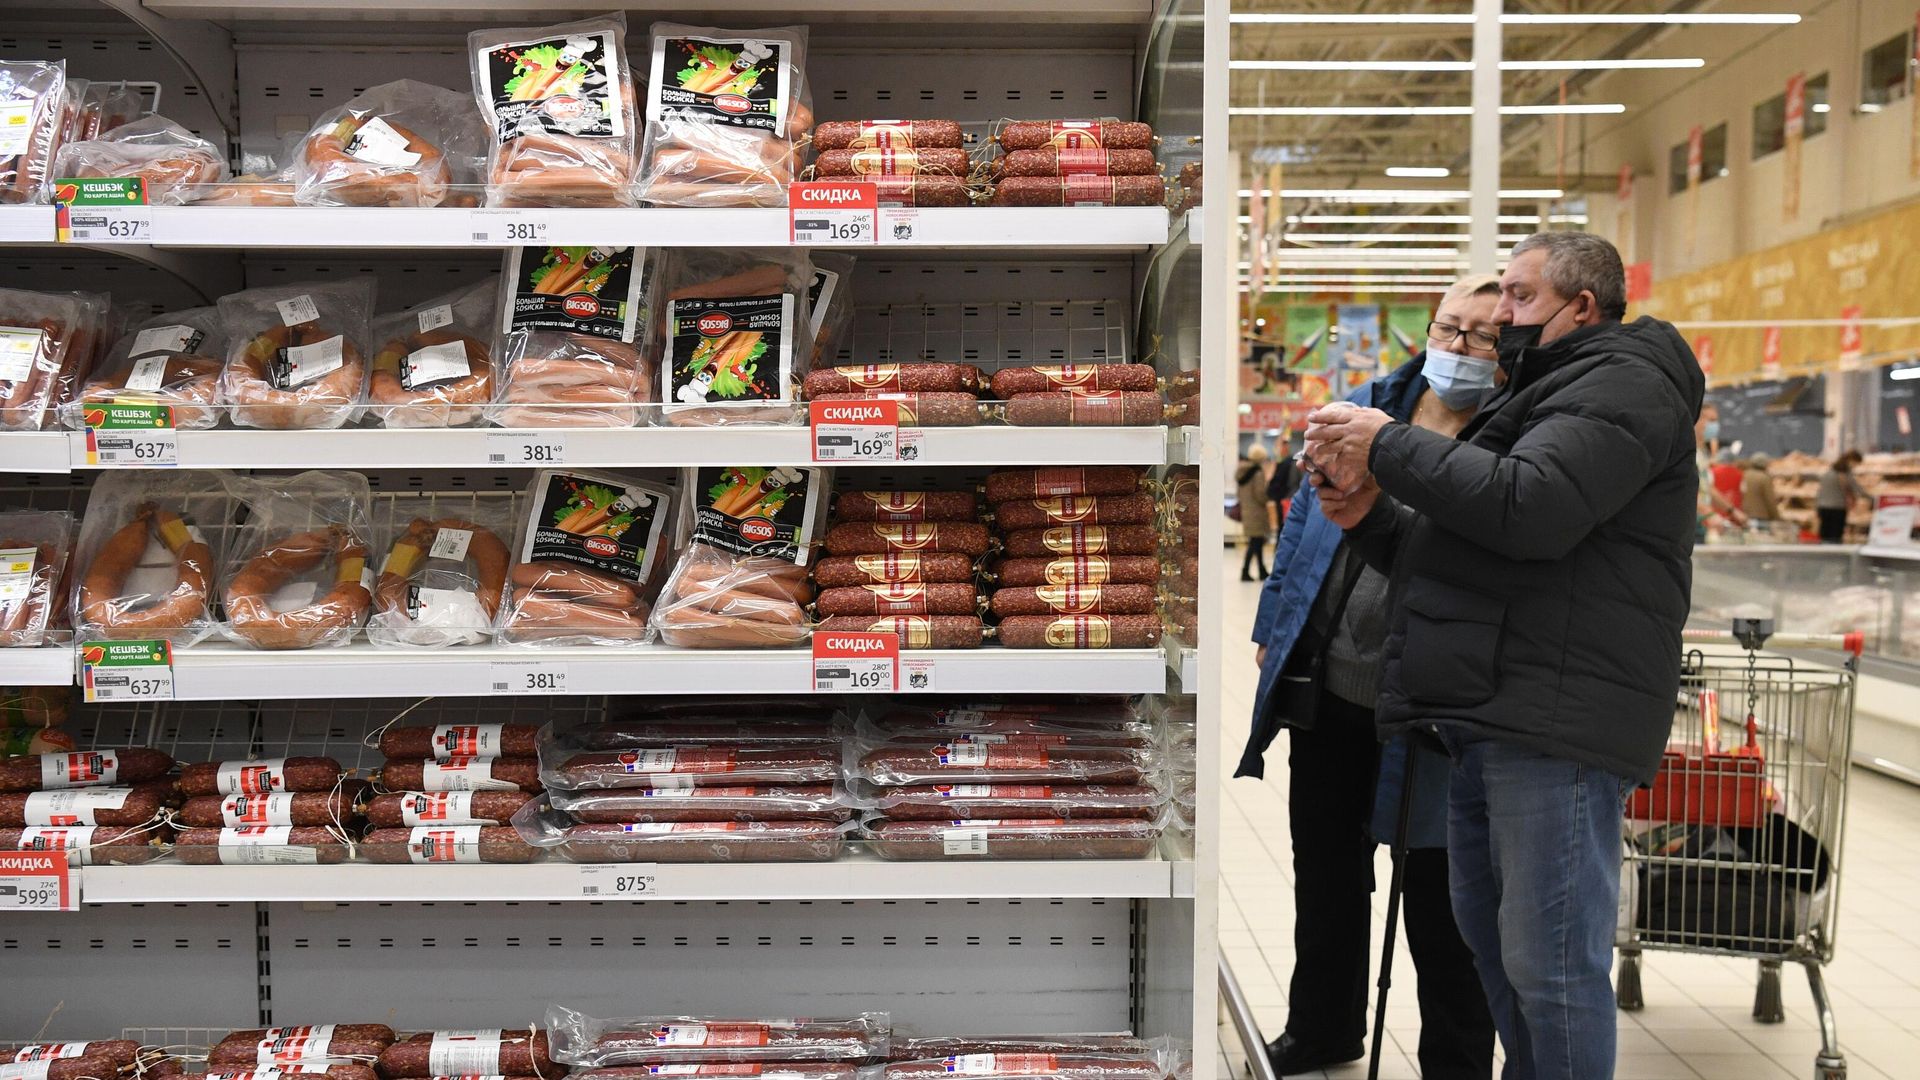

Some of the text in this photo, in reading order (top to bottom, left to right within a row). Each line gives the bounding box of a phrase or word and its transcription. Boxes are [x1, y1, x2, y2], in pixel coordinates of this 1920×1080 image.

[82, 183, 124, 192] КЕШБЭК
[802, 189, 862, 204] СКИДКА
[109, 220, 140, 236] 637
[507, 224, 537, 239] 381
[830, 224, 860, 239] 169
[516, 297, 545, 305] БОЛЬШАЯ
[566, 300, 596, 312] BIGSOS
[700, 320, 729, 329] BIGSOS
[111, 409, 152, 418] КЕШБЭК
[824, 407, 883, 421] СКИДКА
[135, 443, 165, 458] 637
[524, 445, 553, 460] 381
[853, 440, 882, 455] 169
[699, 510, 724, 521] ОЛЬШАЯ
[537, 531, 567, 540] БОЛЬШАЯ
[742, 523, 773, 537] BIGSOS
[587, 540, 616, 554] BIGSOS
[110, 645, 150, 654] КЕШБЭК
[826, 638, 884, 652] СКИДКА
[526, 673, 556, 688] 381
[851, 672, 880, 687] 169
[131, 680, 160, 694] 637
[616, 876, 646, 891] 875
[19, 890, 48, 905] 599
